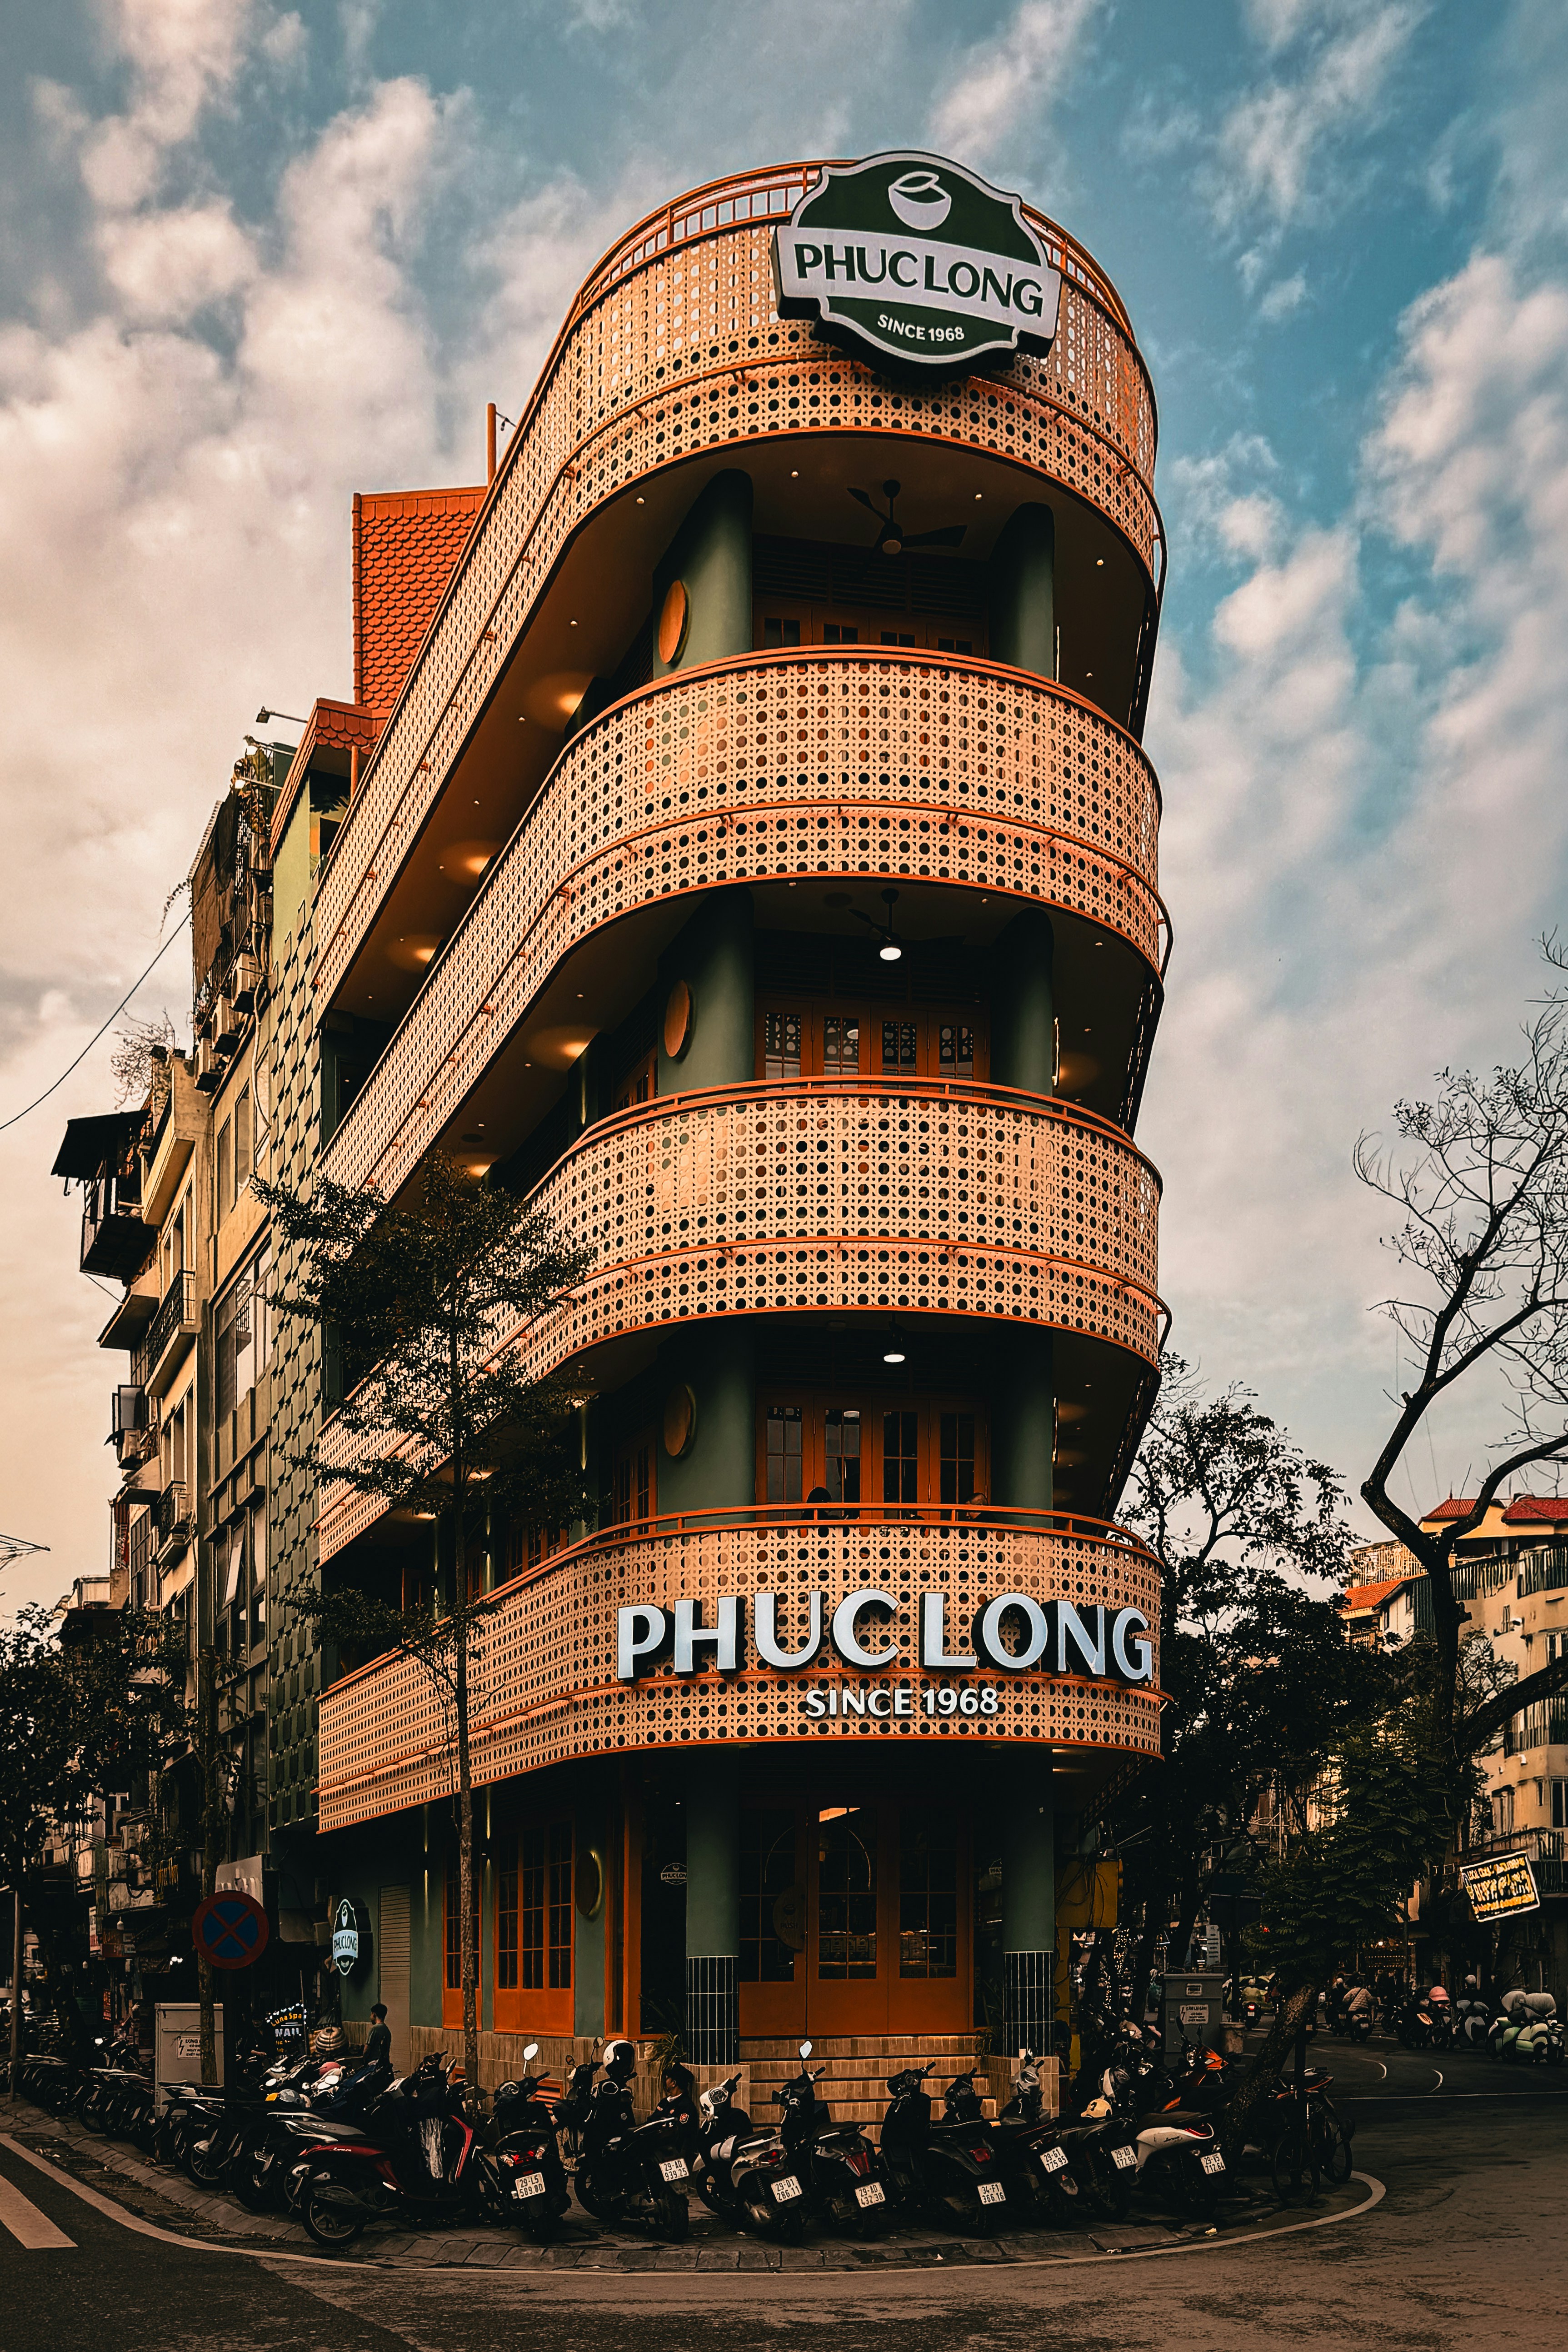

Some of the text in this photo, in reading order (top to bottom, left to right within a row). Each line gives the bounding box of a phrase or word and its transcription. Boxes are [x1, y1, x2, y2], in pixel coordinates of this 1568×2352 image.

[877, 315, 965, 342] SINCE 1968
[805, 1687, 999, 1717] SINCE 1968
[664, 2167, 687, 2180] 939.25
[519, 2183, 543, 2197] 589.80
[777, 2185, 800, 2201] 286.11
[982, 2192, 1004, 2203] 366.16
